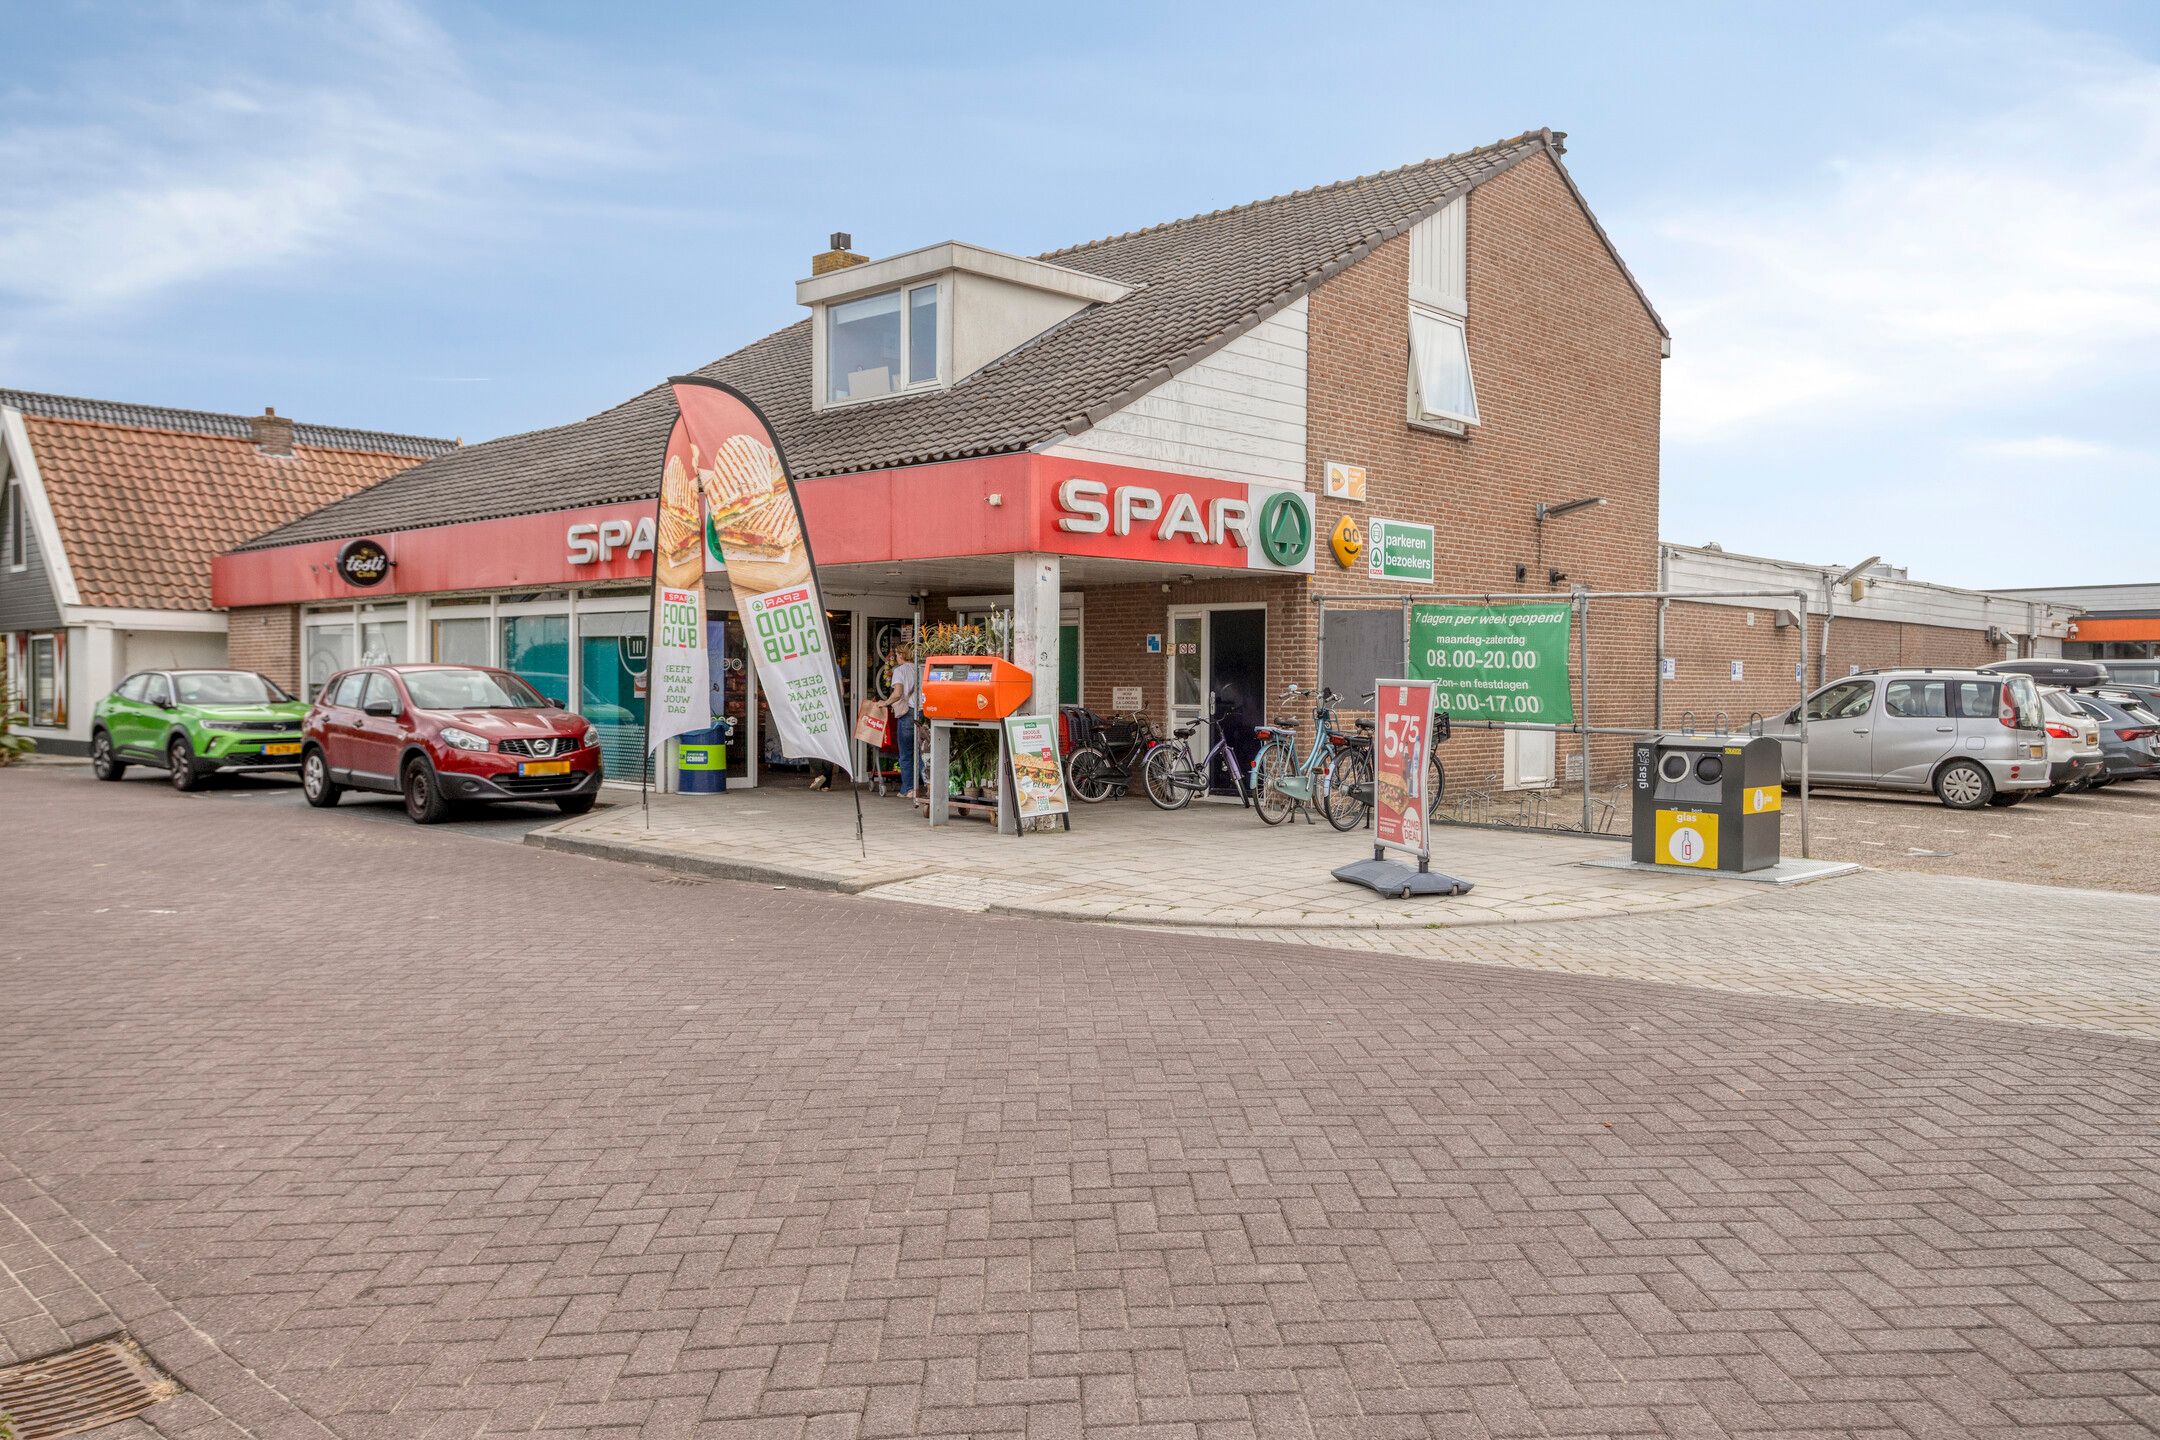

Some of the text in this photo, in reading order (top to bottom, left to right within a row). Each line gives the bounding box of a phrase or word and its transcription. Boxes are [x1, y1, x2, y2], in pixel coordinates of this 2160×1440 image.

[1058, 478, 1252, 548] SPAR
[566, 517, 657, 564] SPA
[1385, 533, 1426, 549] parkeren
[345, 554, 386, 572] tosti
[1385, 551, 1431, 570] bezoekers
[663, 603, 697, 626] FOOD
[1415, 612, 1565, 626] 7 dagen per week geopend
[662, 626, 697, 649] CLUB
[1436, 635, 1526, 646] maandag-zaterdag
[1426, 649, 1537, 669] 08.00-20.00
[666, 665, 692, 673] EEFT
[663, 675, 693, 684] SMAAK
[1436, 677, 1459, 686] Zon-
[1473, 678, 1529, 690] feestdagen
[667, 685, 686, 693] AAN
[663, 695, 691, 704] JOUW
[667, 706, 687, 714] DAG
[1636, 766, 1649, 789] glas
[1676, 812, 1697, 824] glas
